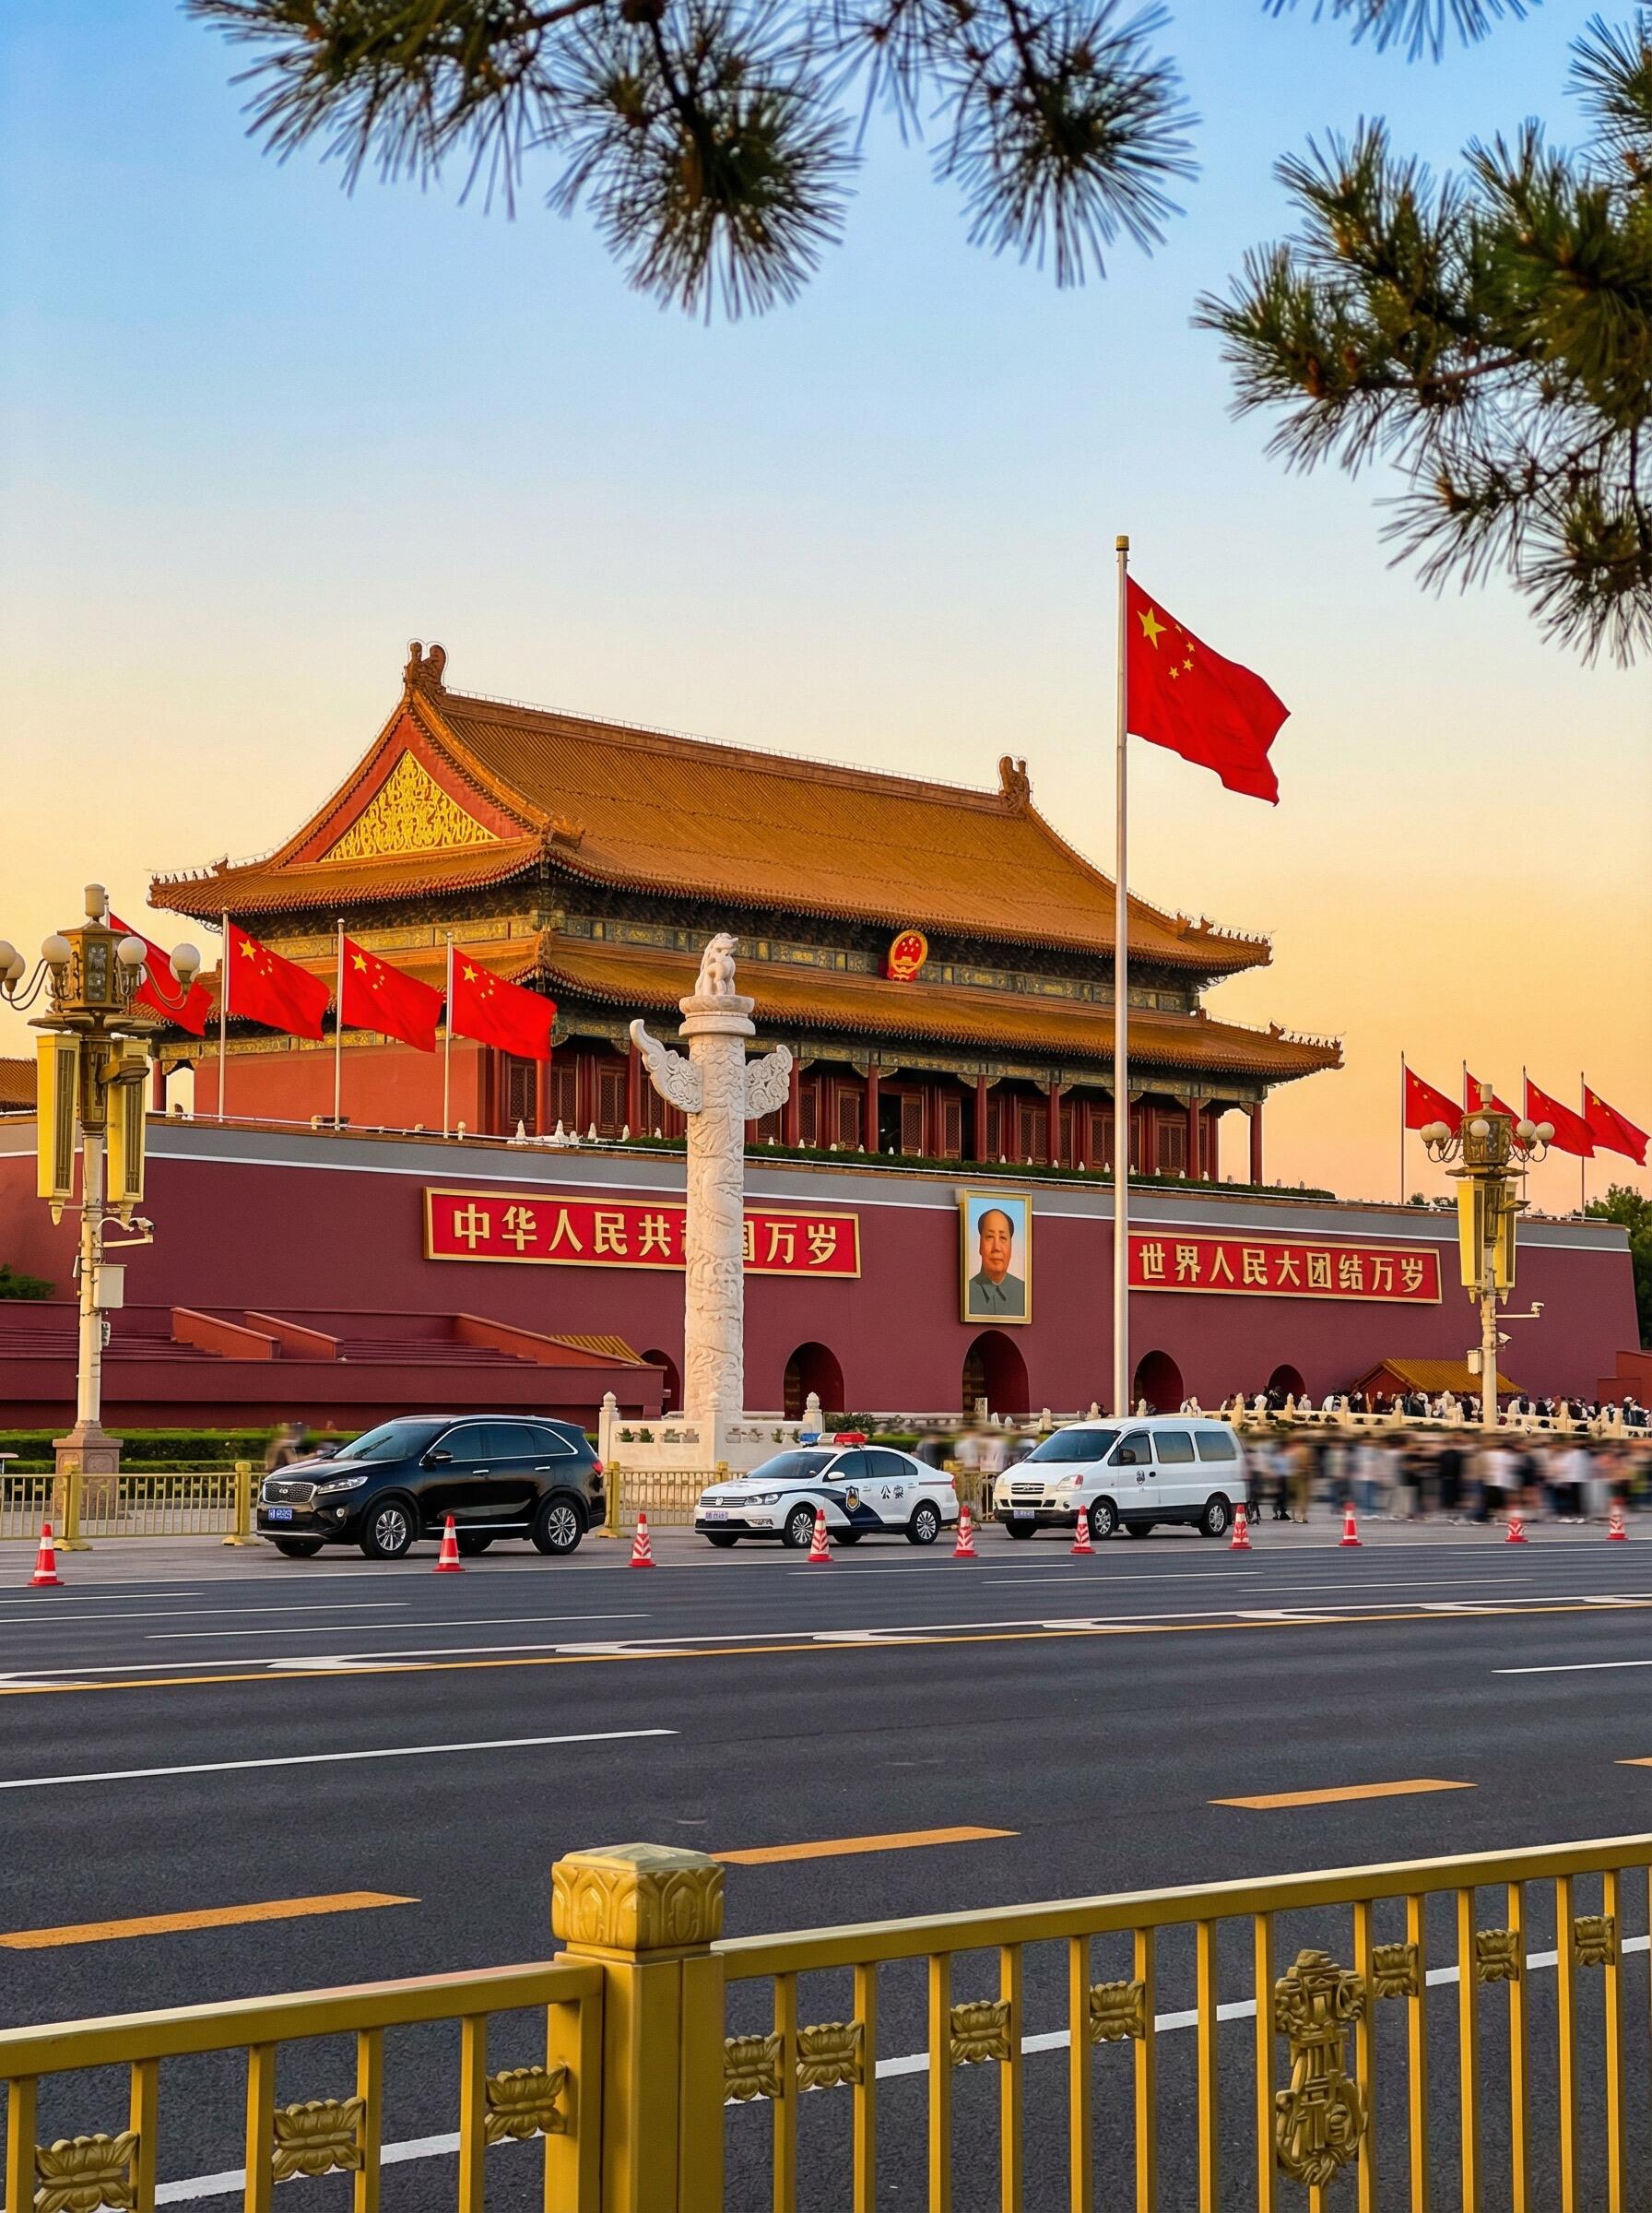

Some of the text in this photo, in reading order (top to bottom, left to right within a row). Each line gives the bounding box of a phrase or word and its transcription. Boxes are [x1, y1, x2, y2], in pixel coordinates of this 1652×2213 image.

[453, 1203, 837, 1265] 中华人民共万岁
[1139, 1242, 1424, 1293] 世界人民大团结万岁
